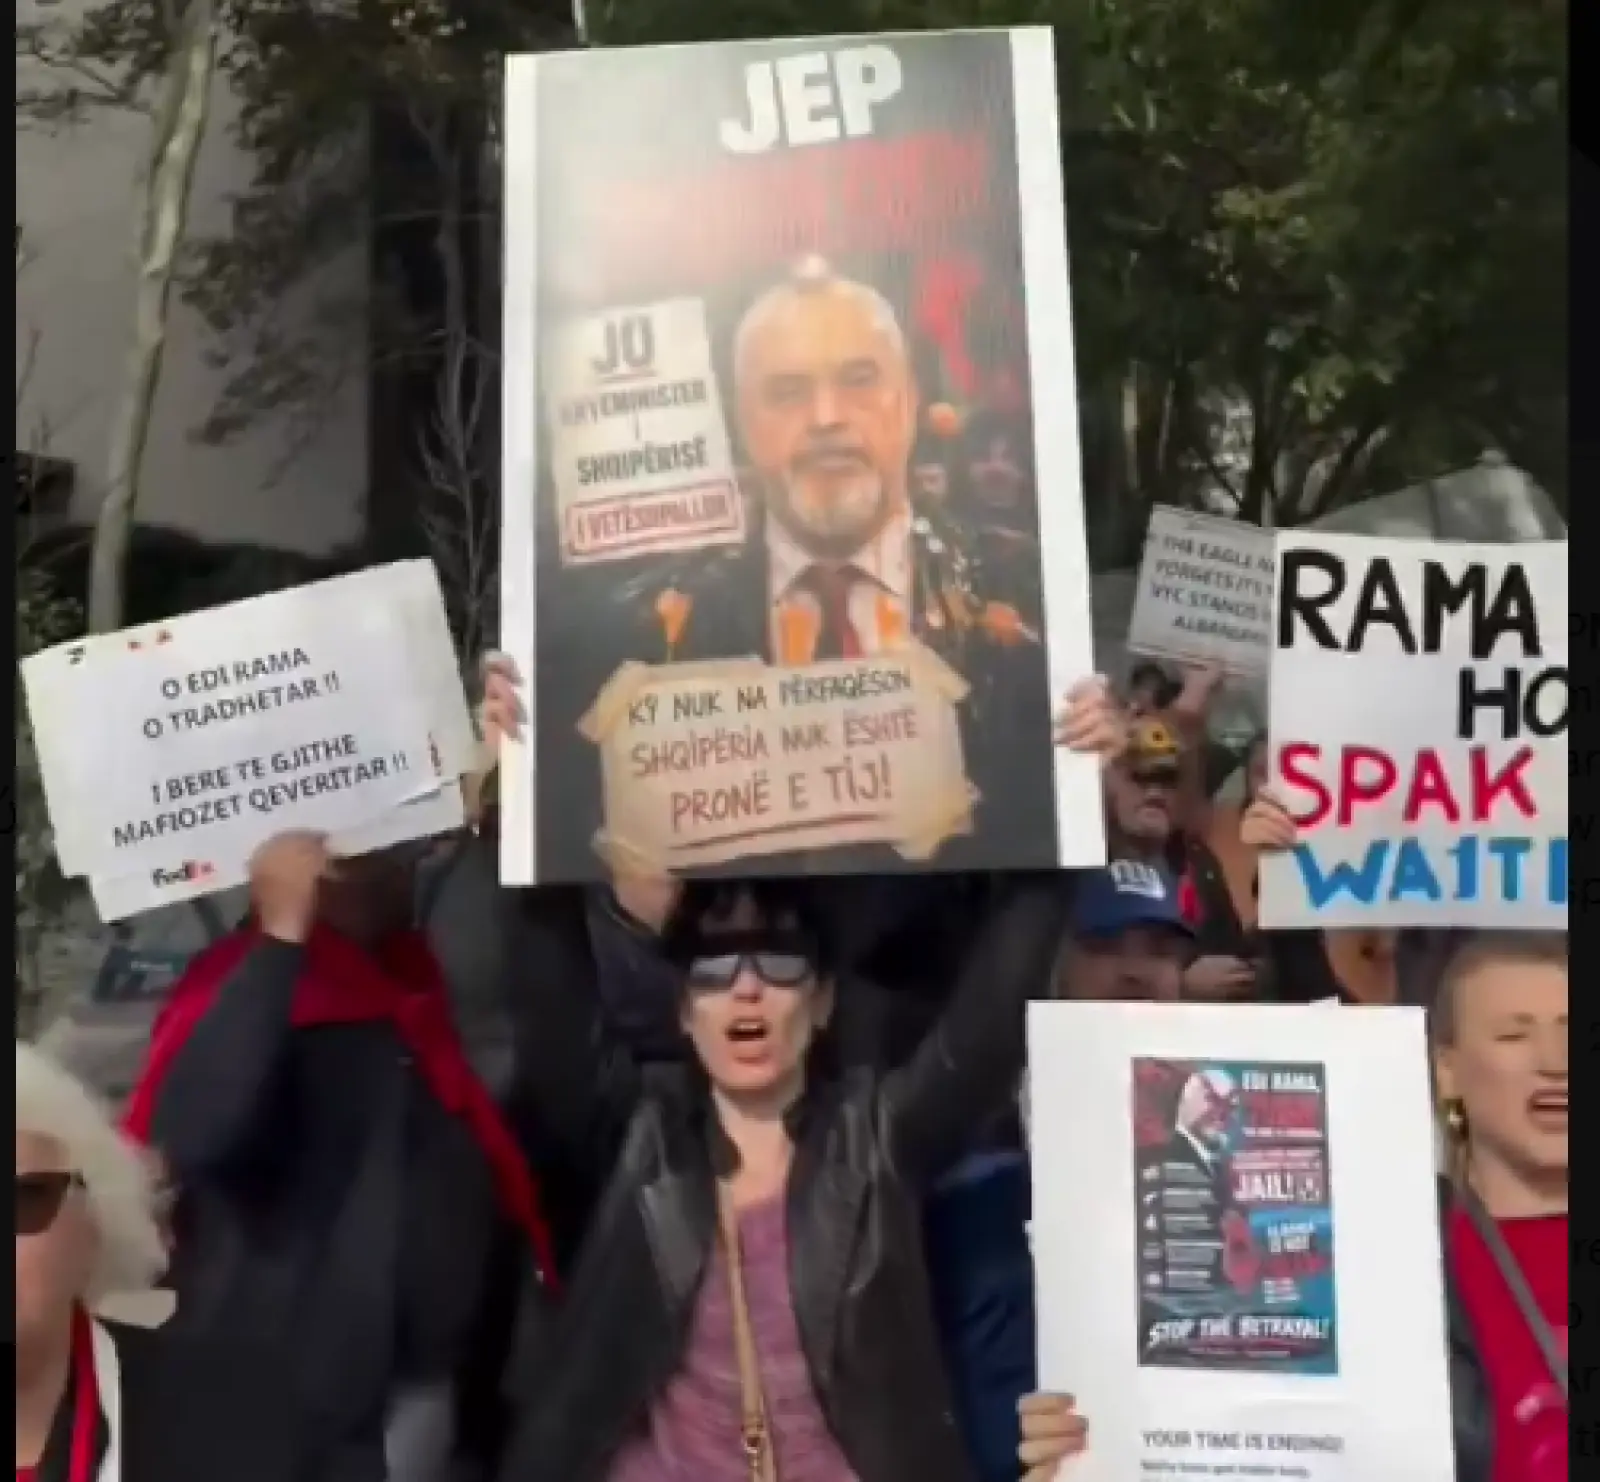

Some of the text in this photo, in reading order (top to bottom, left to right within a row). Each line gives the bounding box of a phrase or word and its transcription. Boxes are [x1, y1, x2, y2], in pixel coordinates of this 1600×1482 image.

[719, 46, 902, 154] JEP
[591, 315, 655, 374] JO
[1278, 549, 1542, 659] RAMA
[161, 648, 311, 700] O EDI RAMA
[737, 685, 768, 713] NA
[1459, 667, 1568, 739] HO
[143, 717, 164, 739] O
[167, 676, 322, 732] TRADHETAR
[112, 792, 243, 848] MAFIOZET
[248, 755, 390, 813] QEVERITAR
[165, 765, 231, 801] BERE
[234, 755, 267, 782] TE
[672, 769, 772, 832] PRONË
[788, 772, 811, 809] E
[1278, 742, 1537, 829] SPAK
[1140, 1429, 1192, 1449] YOUR
[1194, 1430, 1240, 1451] TIME
